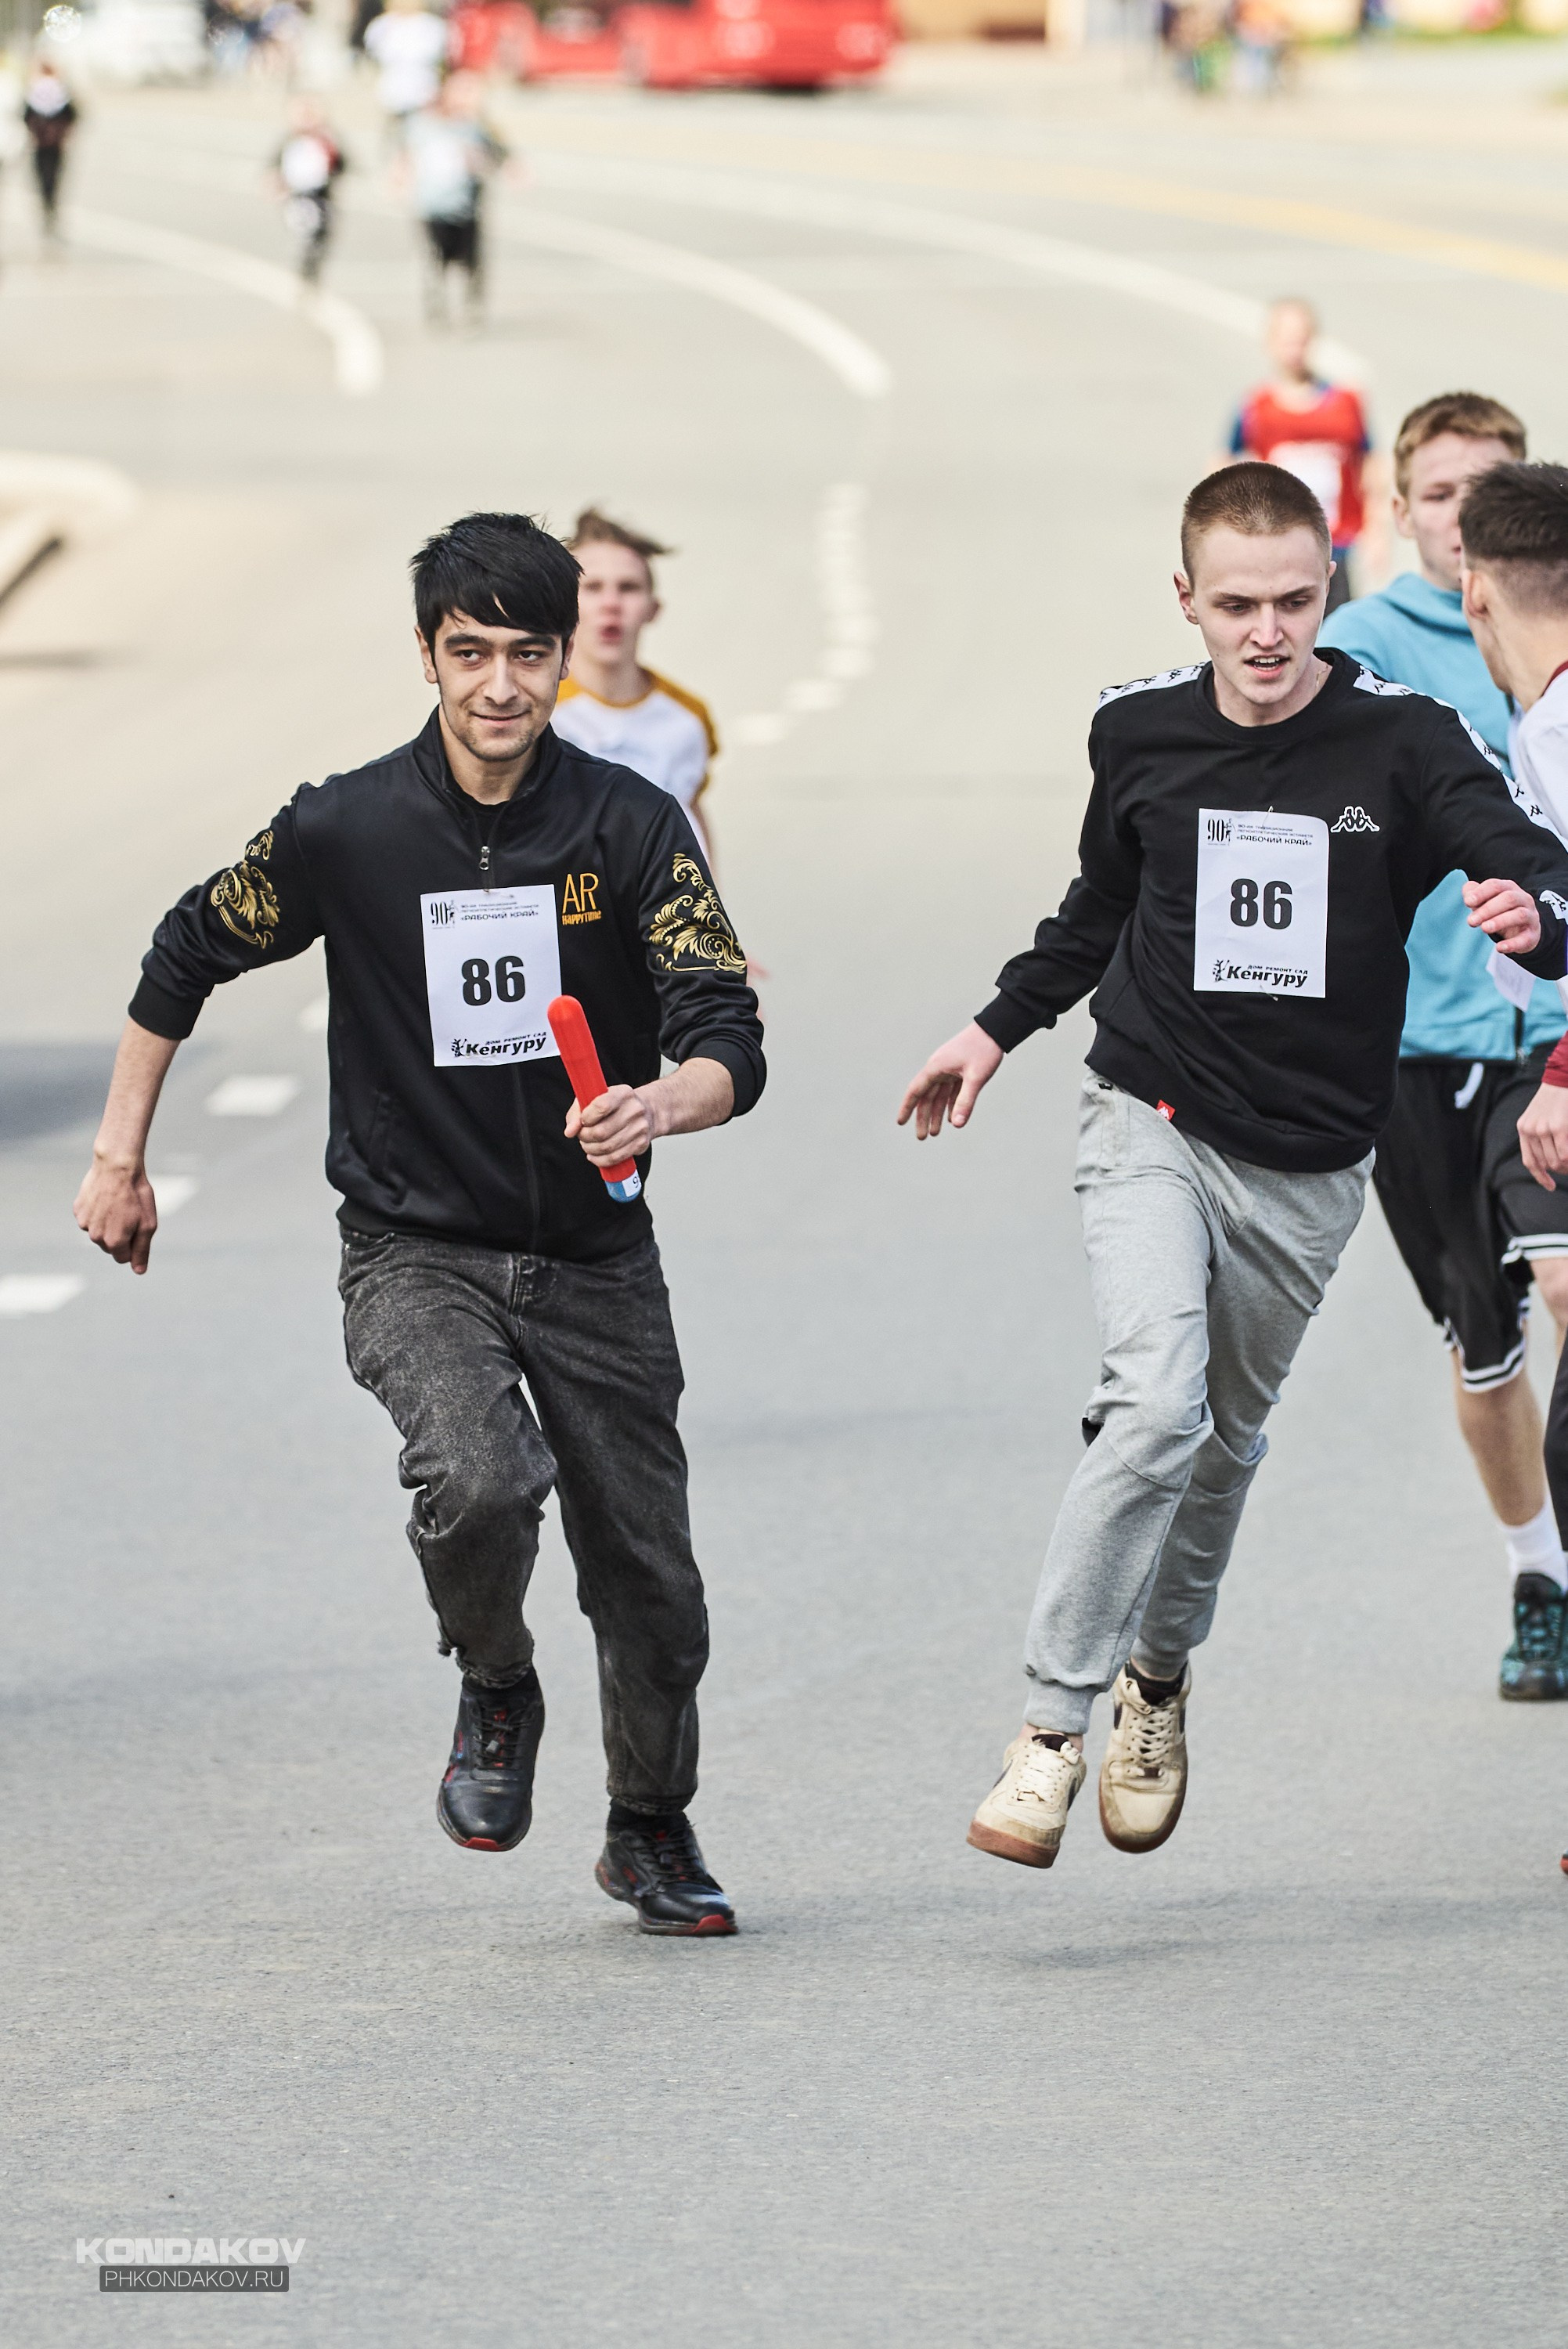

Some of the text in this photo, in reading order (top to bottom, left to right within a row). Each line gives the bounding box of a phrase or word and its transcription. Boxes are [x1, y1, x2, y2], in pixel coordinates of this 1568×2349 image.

[1207, 818, 1225, 842] 90
[563, 872, 599, 914] AR
[1230, 878, 1292, 930] 86
[431, 902, 448, 925] 90
[461, 955, 526, 1006] 86
[1227, 965, 1308, 988] Кенгуру
[466, 1037, 546, 1055] Кенгуру
